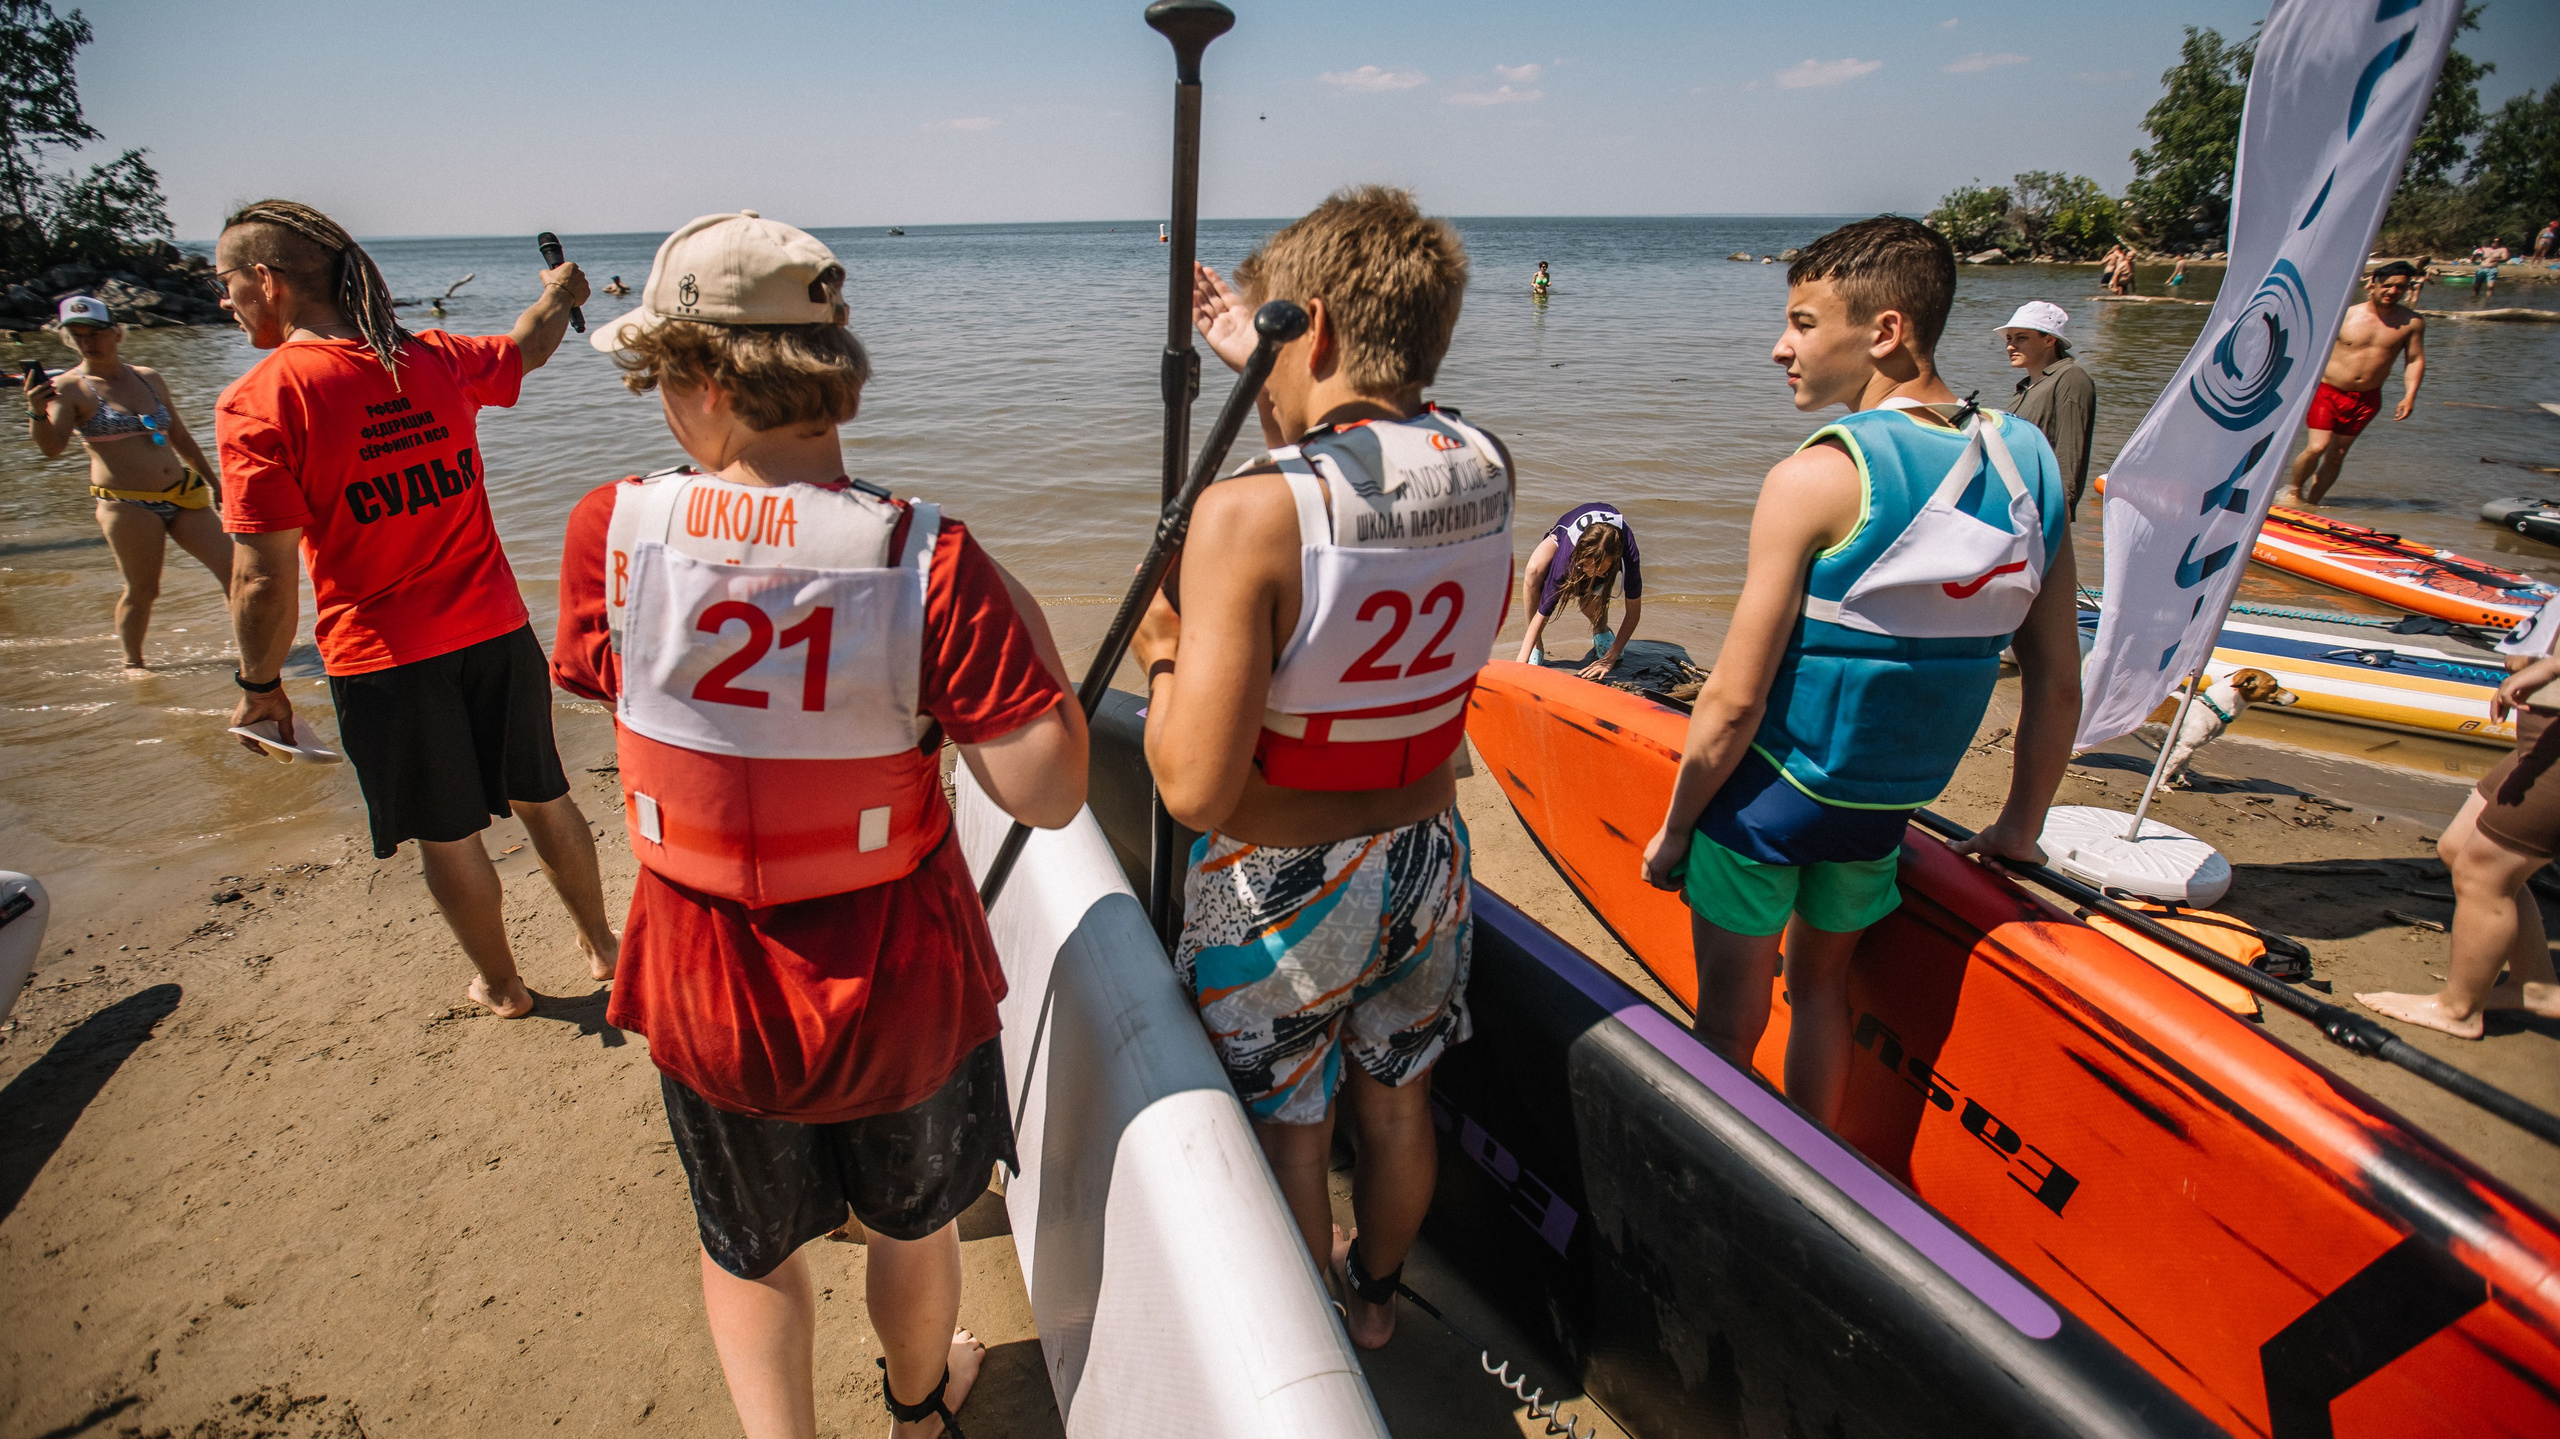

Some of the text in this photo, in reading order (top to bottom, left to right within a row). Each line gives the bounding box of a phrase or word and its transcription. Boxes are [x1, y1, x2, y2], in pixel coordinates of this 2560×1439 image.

[361, 411, 435, 439] ФЕДЕРАЦИЯ
[365, 397, 412, 419] РФСОО
[424, 426, 450, 443] НСО
[345, 448, 476, 525] СУДЬЯ
[686, 486, 798, 547] ШКОЛА
[1356, 511, 1405, 542] ШКОЛА
[1410, 501, 1478, 538] ПАРУСНОГО
[691, 600, 834, 713] 21
[1339, 580, 1465, 683] 22
